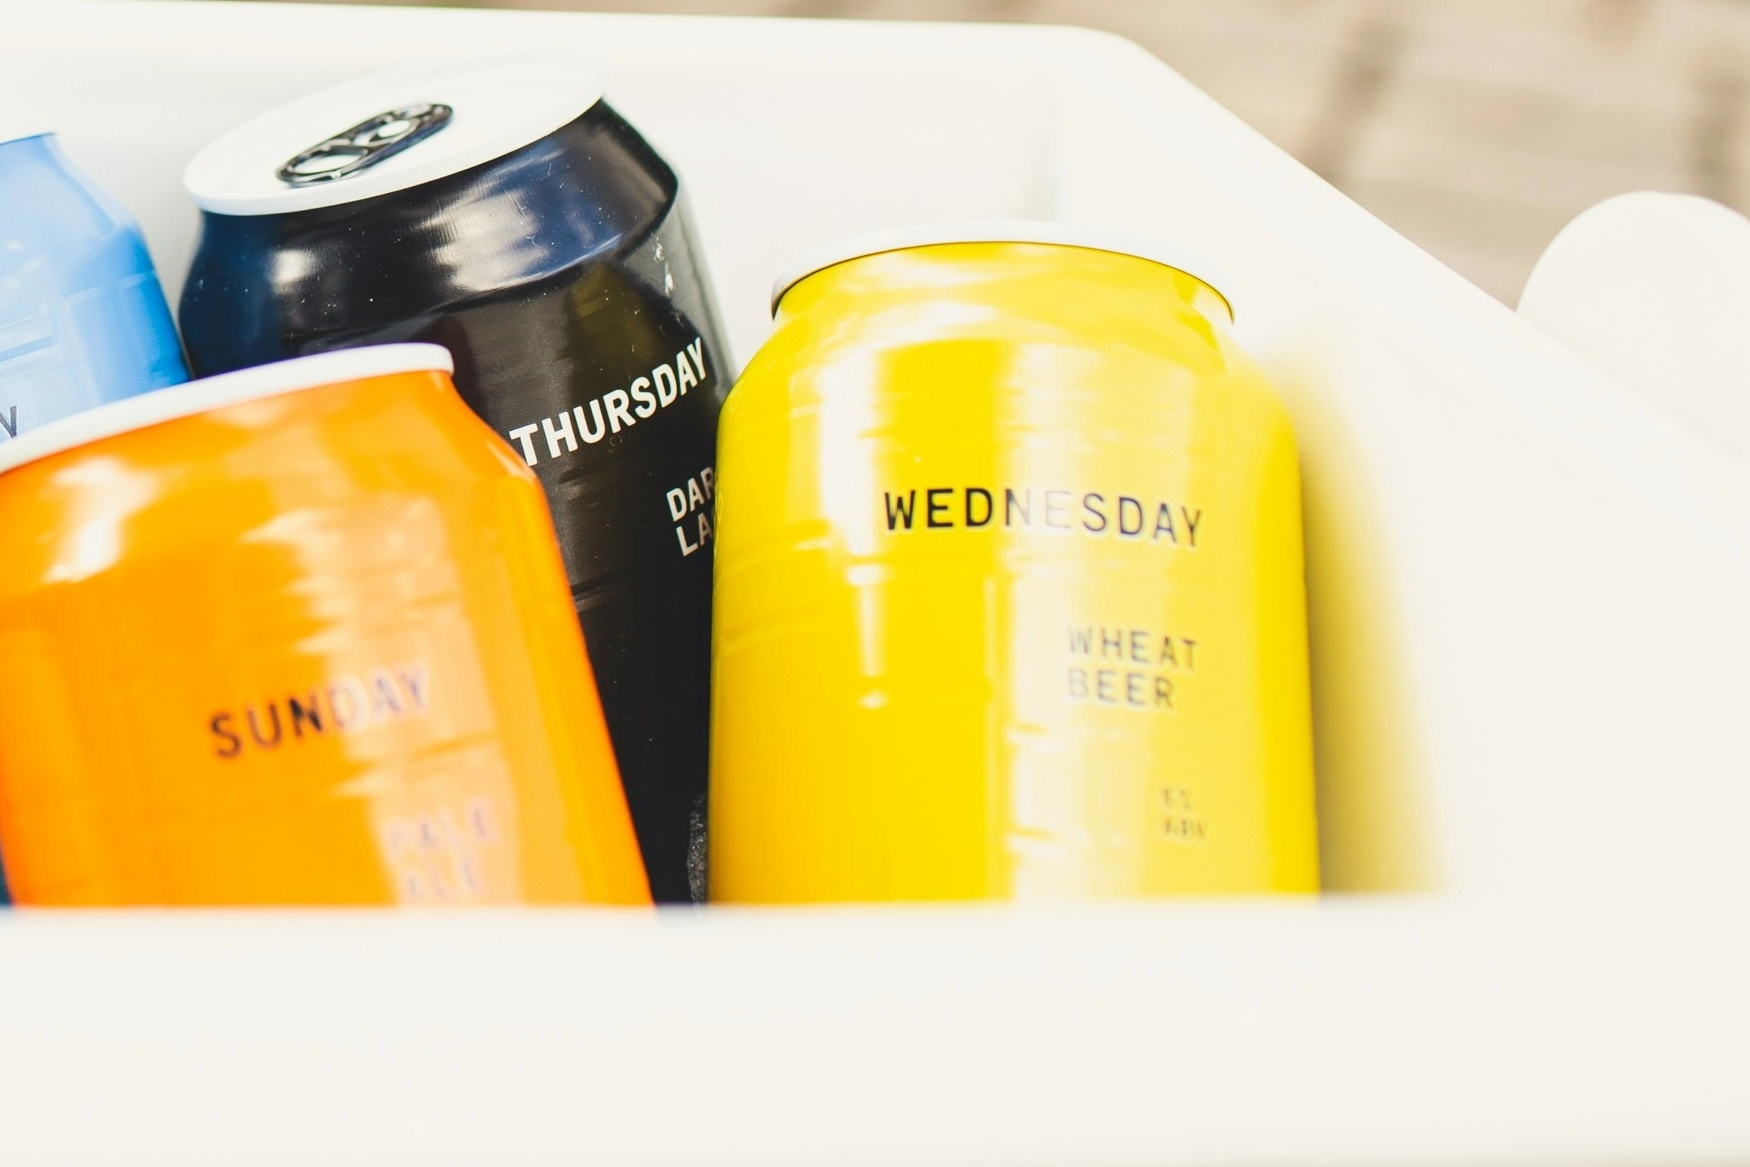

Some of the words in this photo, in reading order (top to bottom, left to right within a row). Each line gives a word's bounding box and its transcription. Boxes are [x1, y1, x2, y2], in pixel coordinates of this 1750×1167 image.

[509, 337, 707, 467] THURSDAY
[884, 487, 1201, 548] WEDNESDAY
[1068, 625, 1199, 672] WHEAT
[210, 668, 425, 759] SUNDAY
[1067, 668, 1175, 710] BEER
